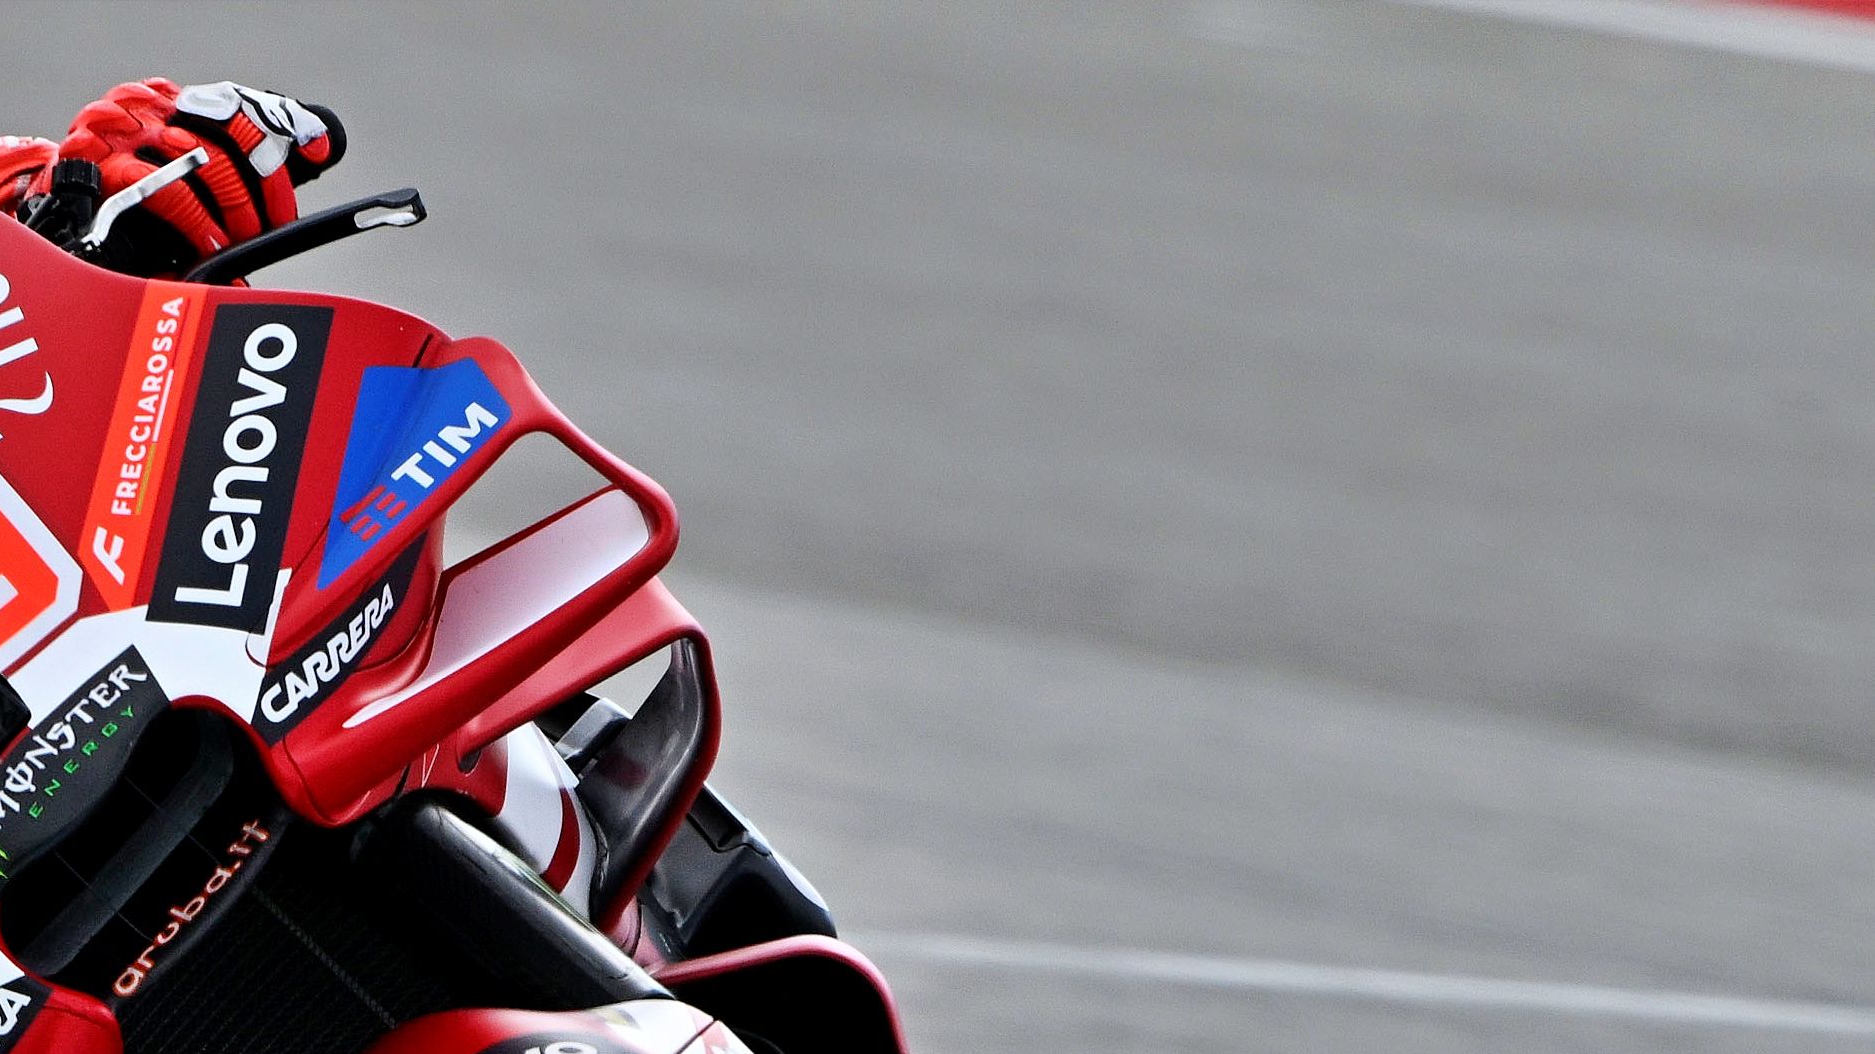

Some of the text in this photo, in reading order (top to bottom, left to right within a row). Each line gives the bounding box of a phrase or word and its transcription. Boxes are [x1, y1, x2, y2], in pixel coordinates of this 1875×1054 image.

[110, 295, 184, 516] FRECCIAROSSA
[173, 322, 298, 608] Lenovo
[390, 401, 500, 489] TIM
[259, 582, 396, 724] CARRERA
[114, 819, 270, 996] aruba.it
